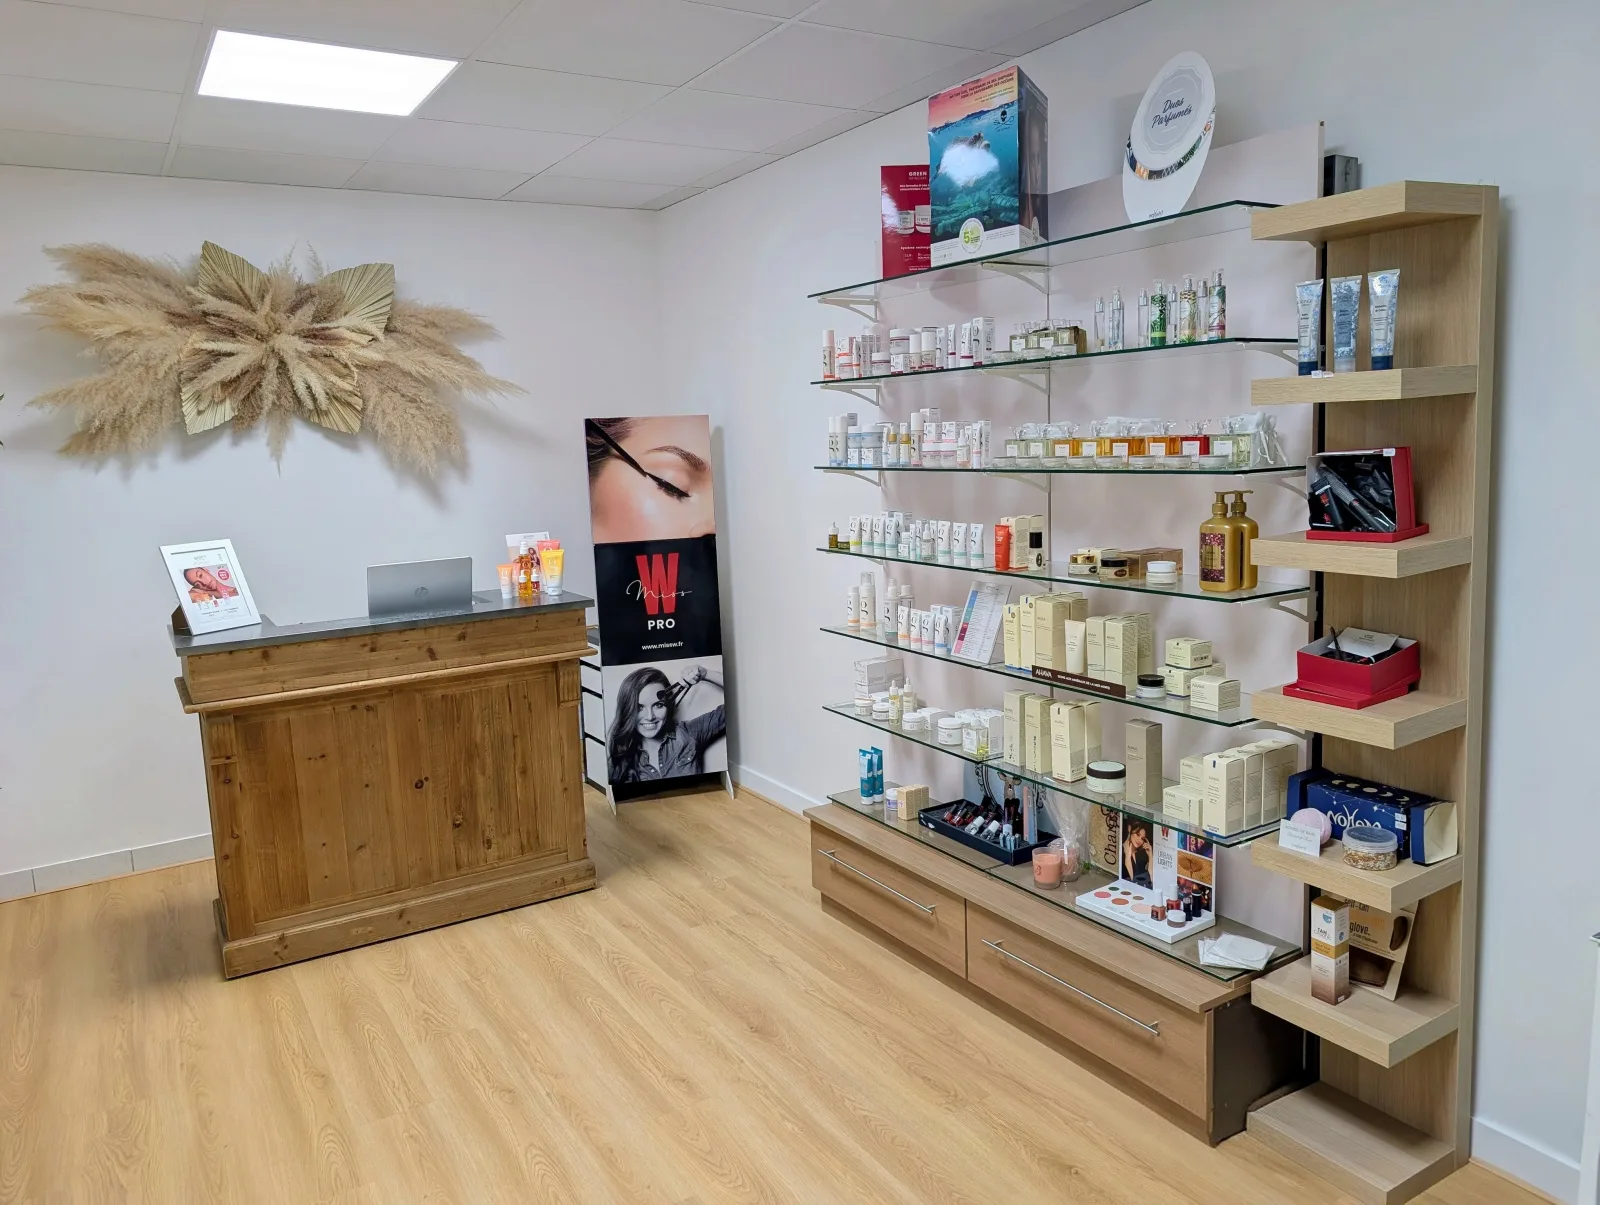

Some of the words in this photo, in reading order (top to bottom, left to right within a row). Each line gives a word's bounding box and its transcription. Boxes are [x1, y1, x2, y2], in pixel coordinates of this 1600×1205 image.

[1162, 97, 1185, 114] Duos
[1151, 104, 1193, 128] Parfumés
[625, 579, 693, 601] Miss
[635, 552, 679, 615] W
[647, 618, 676, 630] PRO
[641, 640, 684, 650] www.missw.fr
[1035, 668, 1053, 679] AHAVA
[1157, 850, 1173, 861] URBAN
[1157, 858, 1173, 869] LIGHTS
[1349, 921, 1370, 936] glove.
